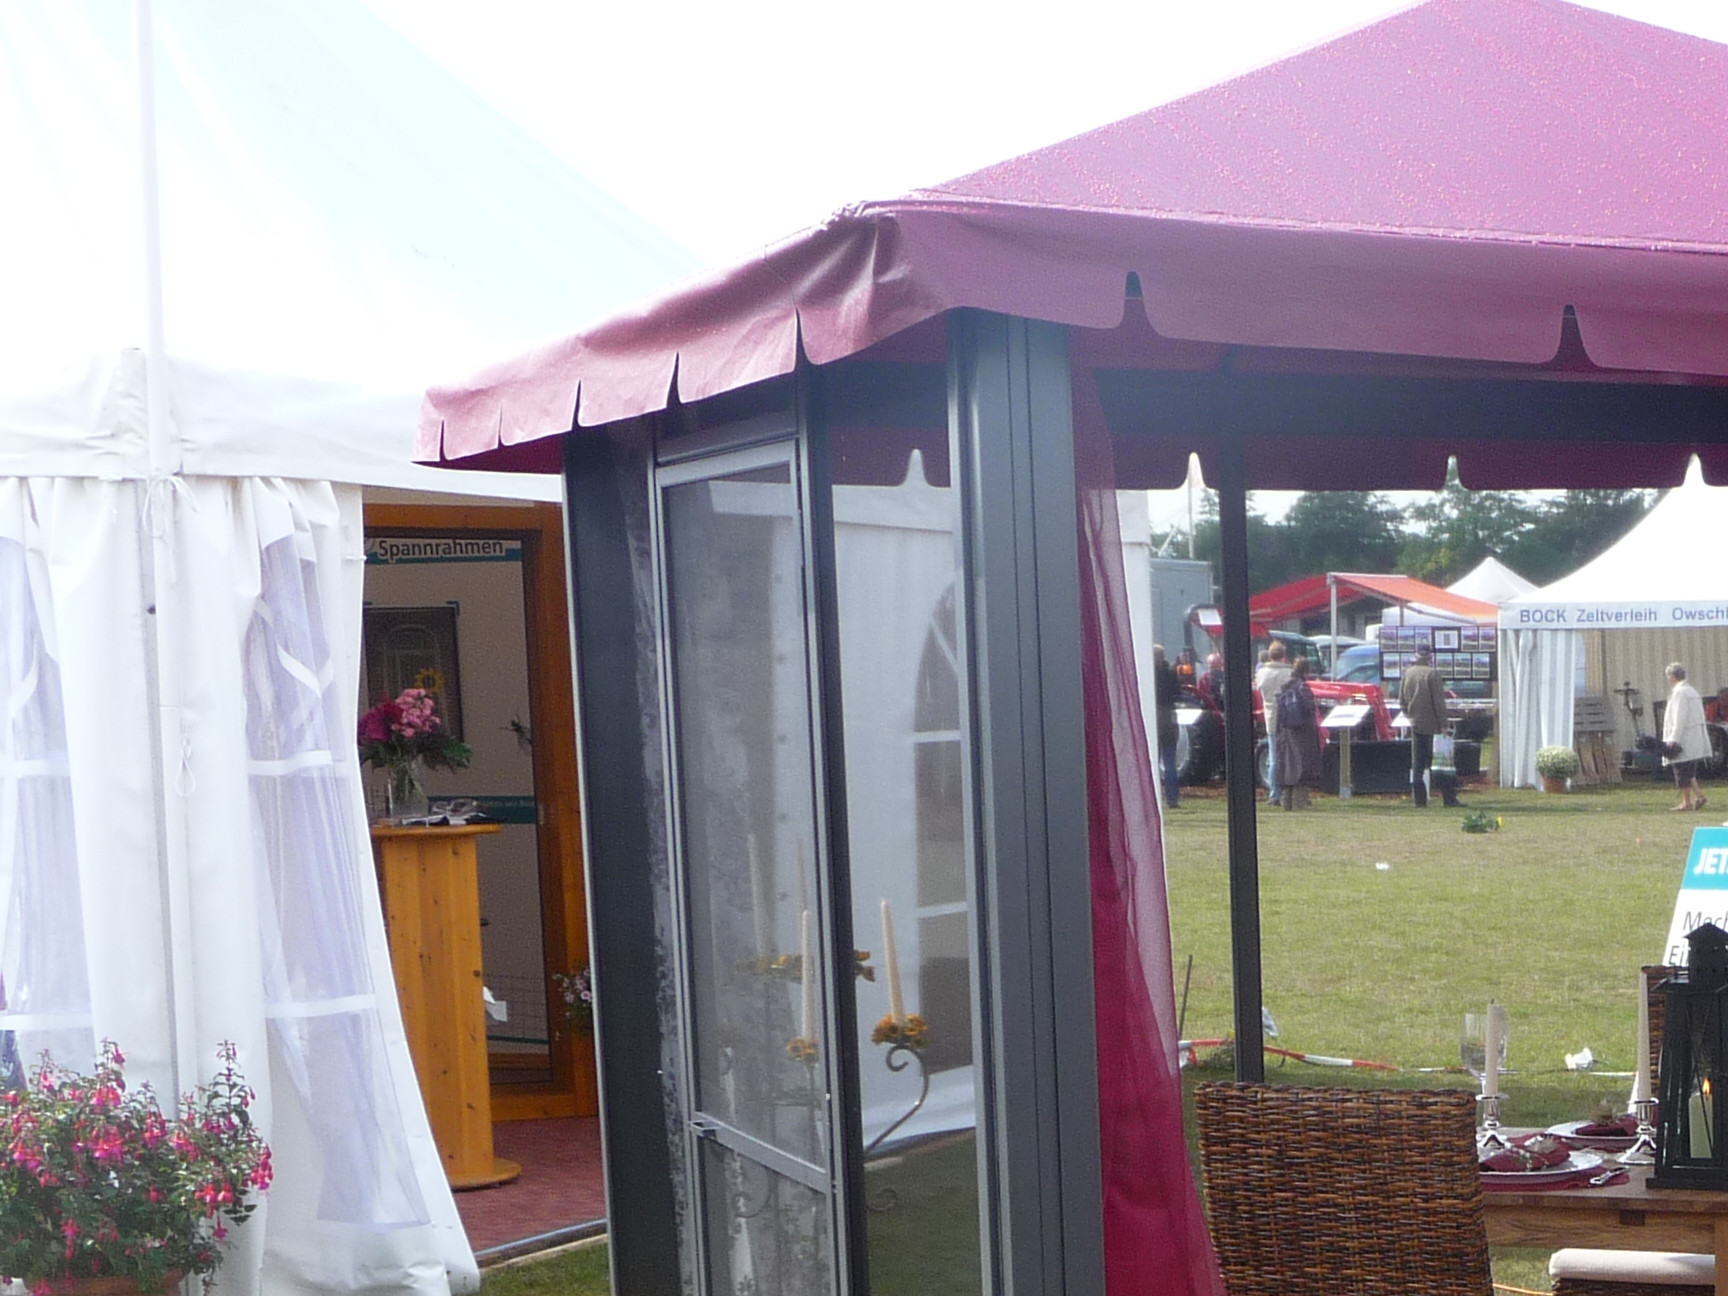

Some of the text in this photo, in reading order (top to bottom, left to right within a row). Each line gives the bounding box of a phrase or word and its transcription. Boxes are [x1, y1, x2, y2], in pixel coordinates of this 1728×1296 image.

[379, 539, 504, 560] Spannrahmen
[1520, 608, 1568, 623] BOCK
[1576, 608, 1658, 623] Zeltverleih
